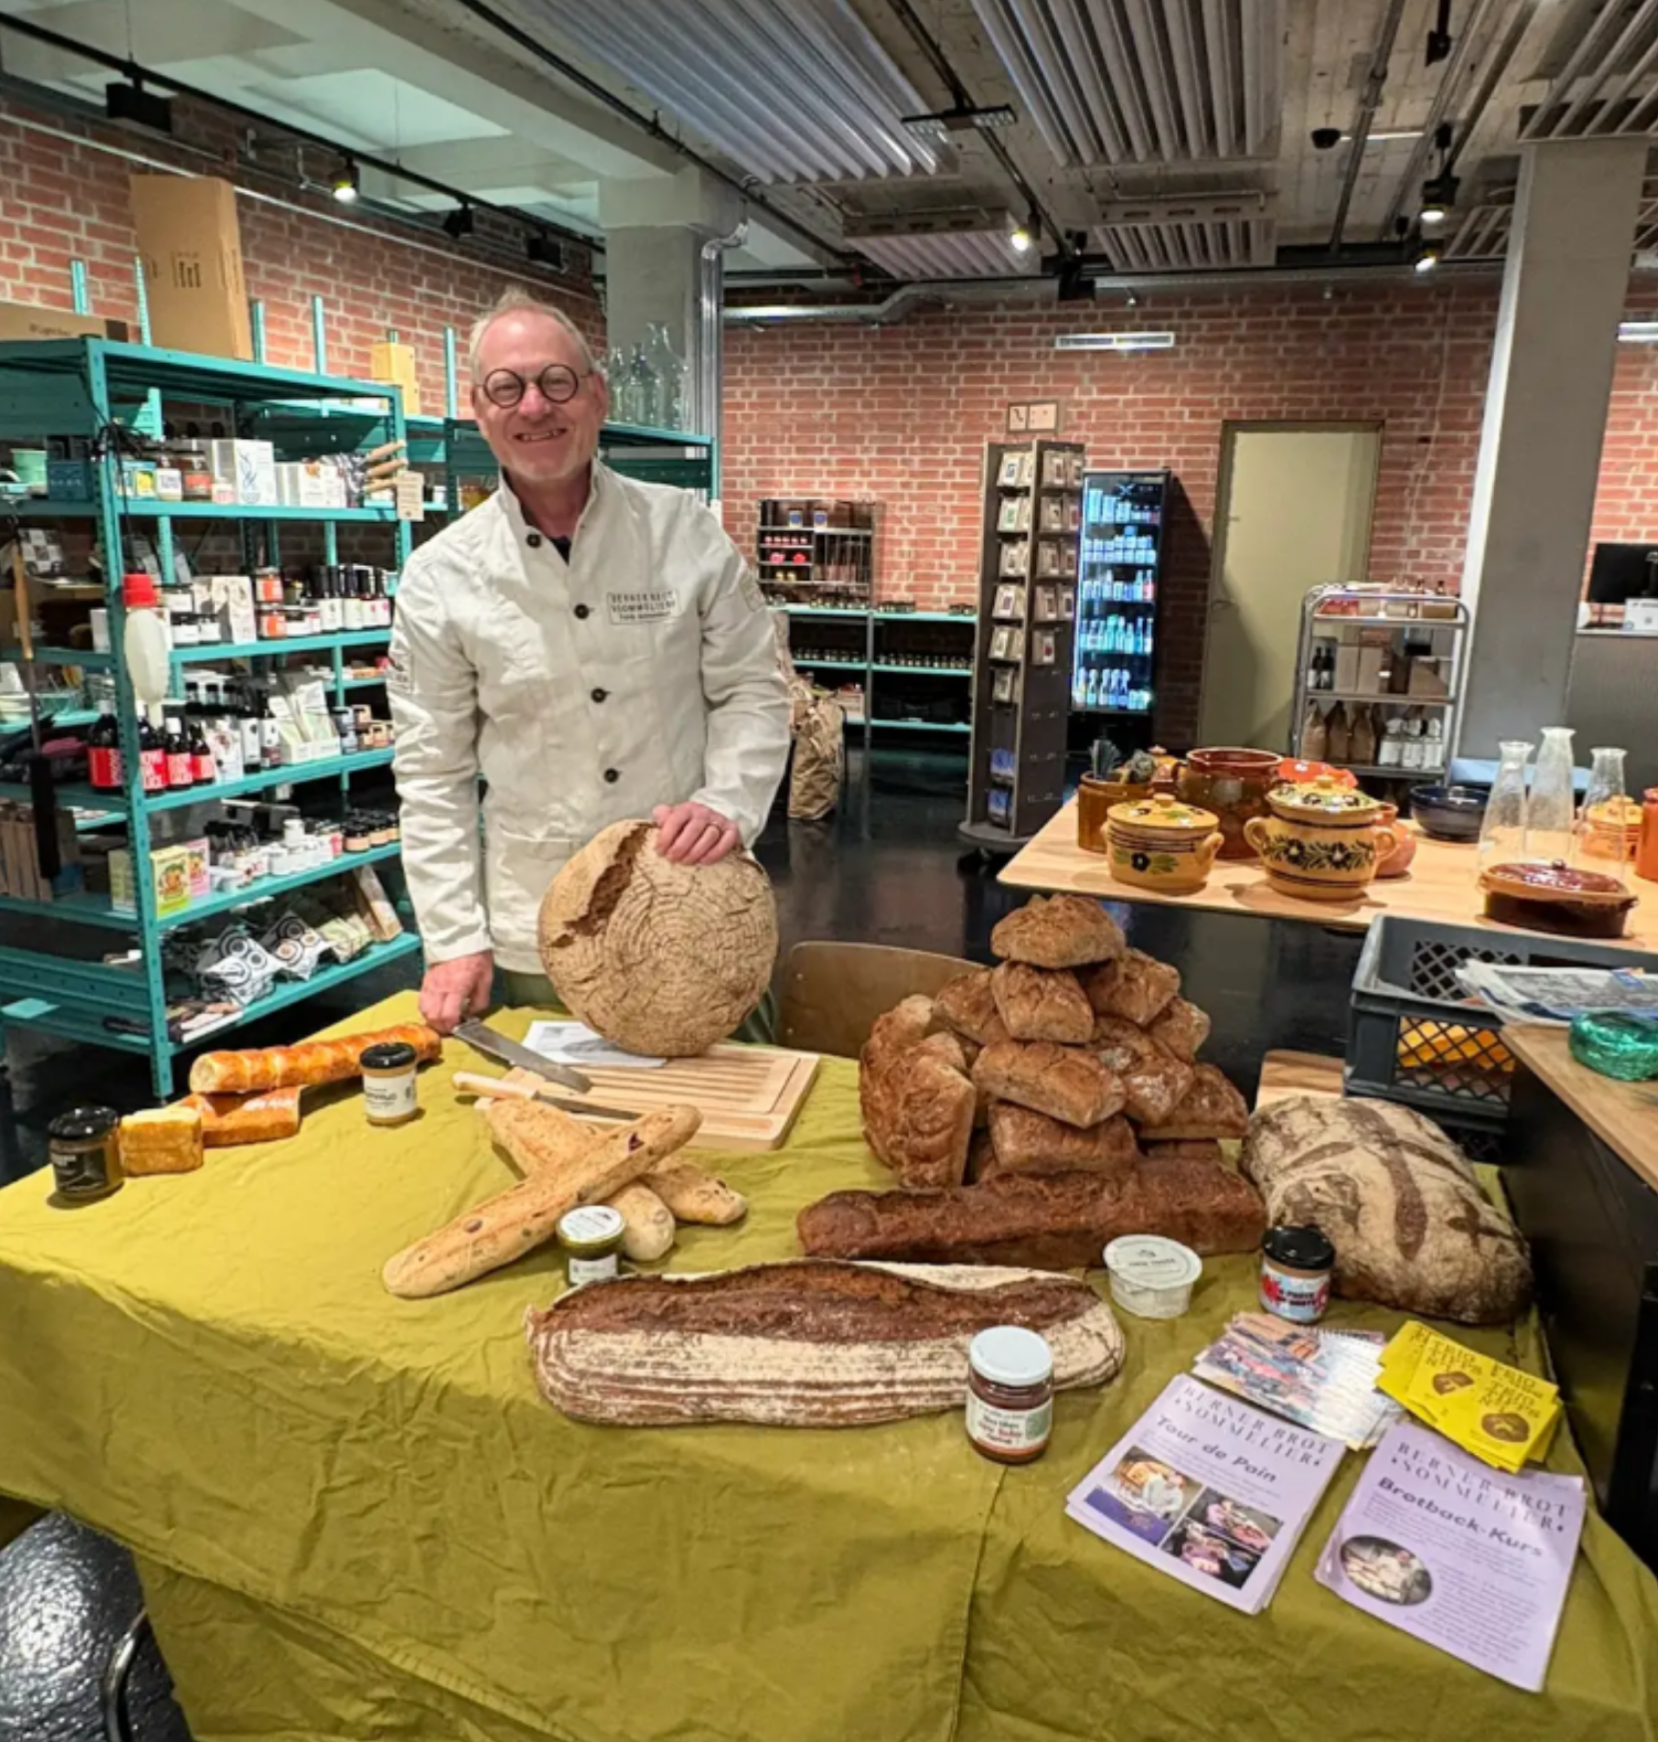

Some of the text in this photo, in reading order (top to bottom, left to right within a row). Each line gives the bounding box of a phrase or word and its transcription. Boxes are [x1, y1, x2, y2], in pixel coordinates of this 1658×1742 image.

[1157, 1415, 1277, 1483] Tour de Pain
[1183, 1385, 1332, 1454] BERNER BROT
[1184, 1403, 1312, 1466] SOMMELIER
[1397, 1442, 1492, 1492] BERNER
